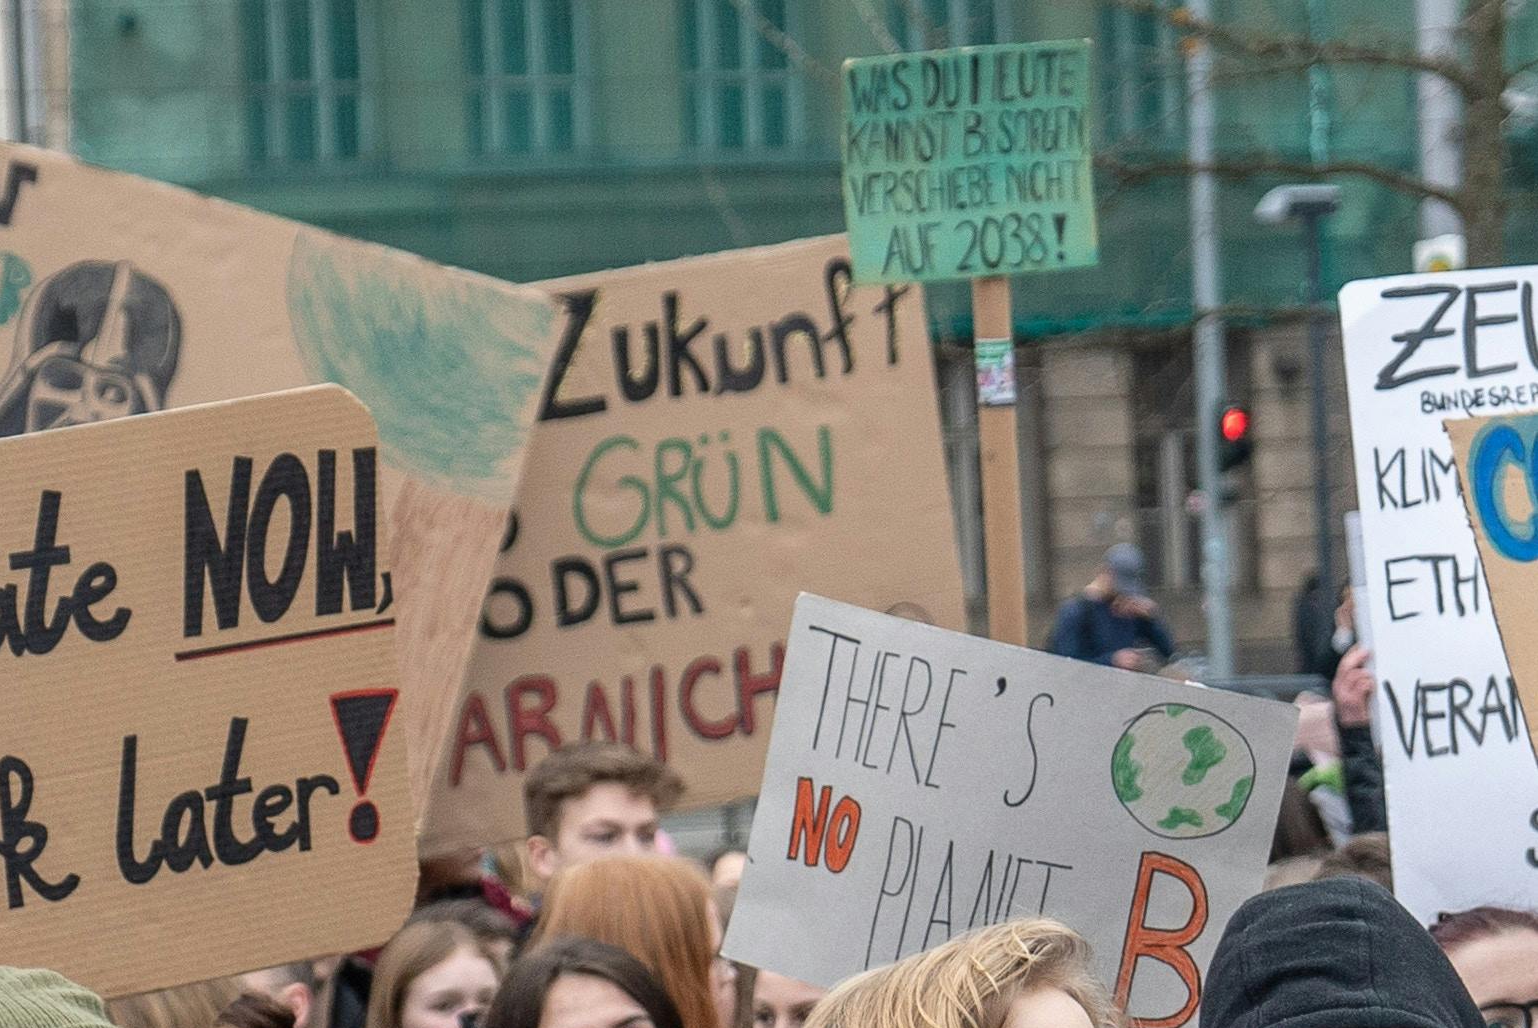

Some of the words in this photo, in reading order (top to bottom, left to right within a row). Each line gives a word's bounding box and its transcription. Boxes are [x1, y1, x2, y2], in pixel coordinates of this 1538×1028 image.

[848, 59, 911, 114] WAS
[921, 57, 960, 108] DU
[848, 163, 1000, 215] VERSCHIEBE
[1005, 158, 1084, 206] NICHT
[881, 221, 943, 276] AUF
[953, 212, 1068, 273] 2038!
[537, 256, 909, 423] Zukunft
[573, 423, 834, 549] GRÜN
[183, 445, 394, 638] NOW,
[480, 543, 705, 639] ODER
[808, 624, 1055, 808] THERE'S
[786, 776, 862, 874] NO
